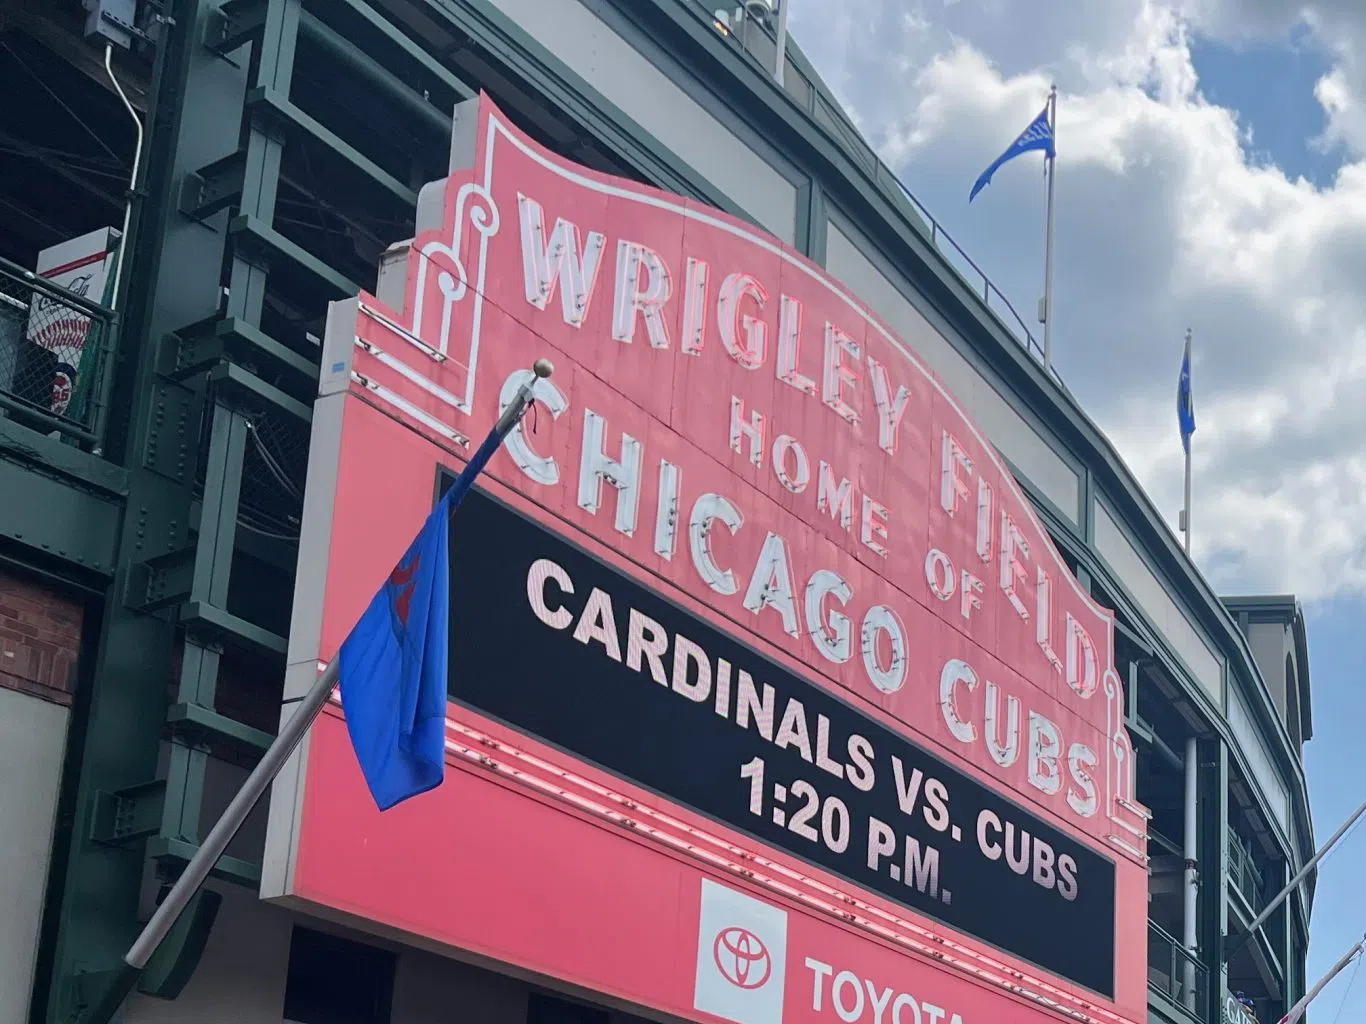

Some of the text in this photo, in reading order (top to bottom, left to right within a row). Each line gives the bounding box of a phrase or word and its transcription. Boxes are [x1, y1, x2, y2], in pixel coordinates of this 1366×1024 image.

[499, 369, 1100, 818] CHICAGO CUBS
[516, 190, 1099, 699] WRIGLEY FIELD
[730, 396, 984, 619] HOME OF
[525, 558, 1079, 902] CARDINALS VS. CUBS
[740, 756, 952, 905] 1:20 P.M.
